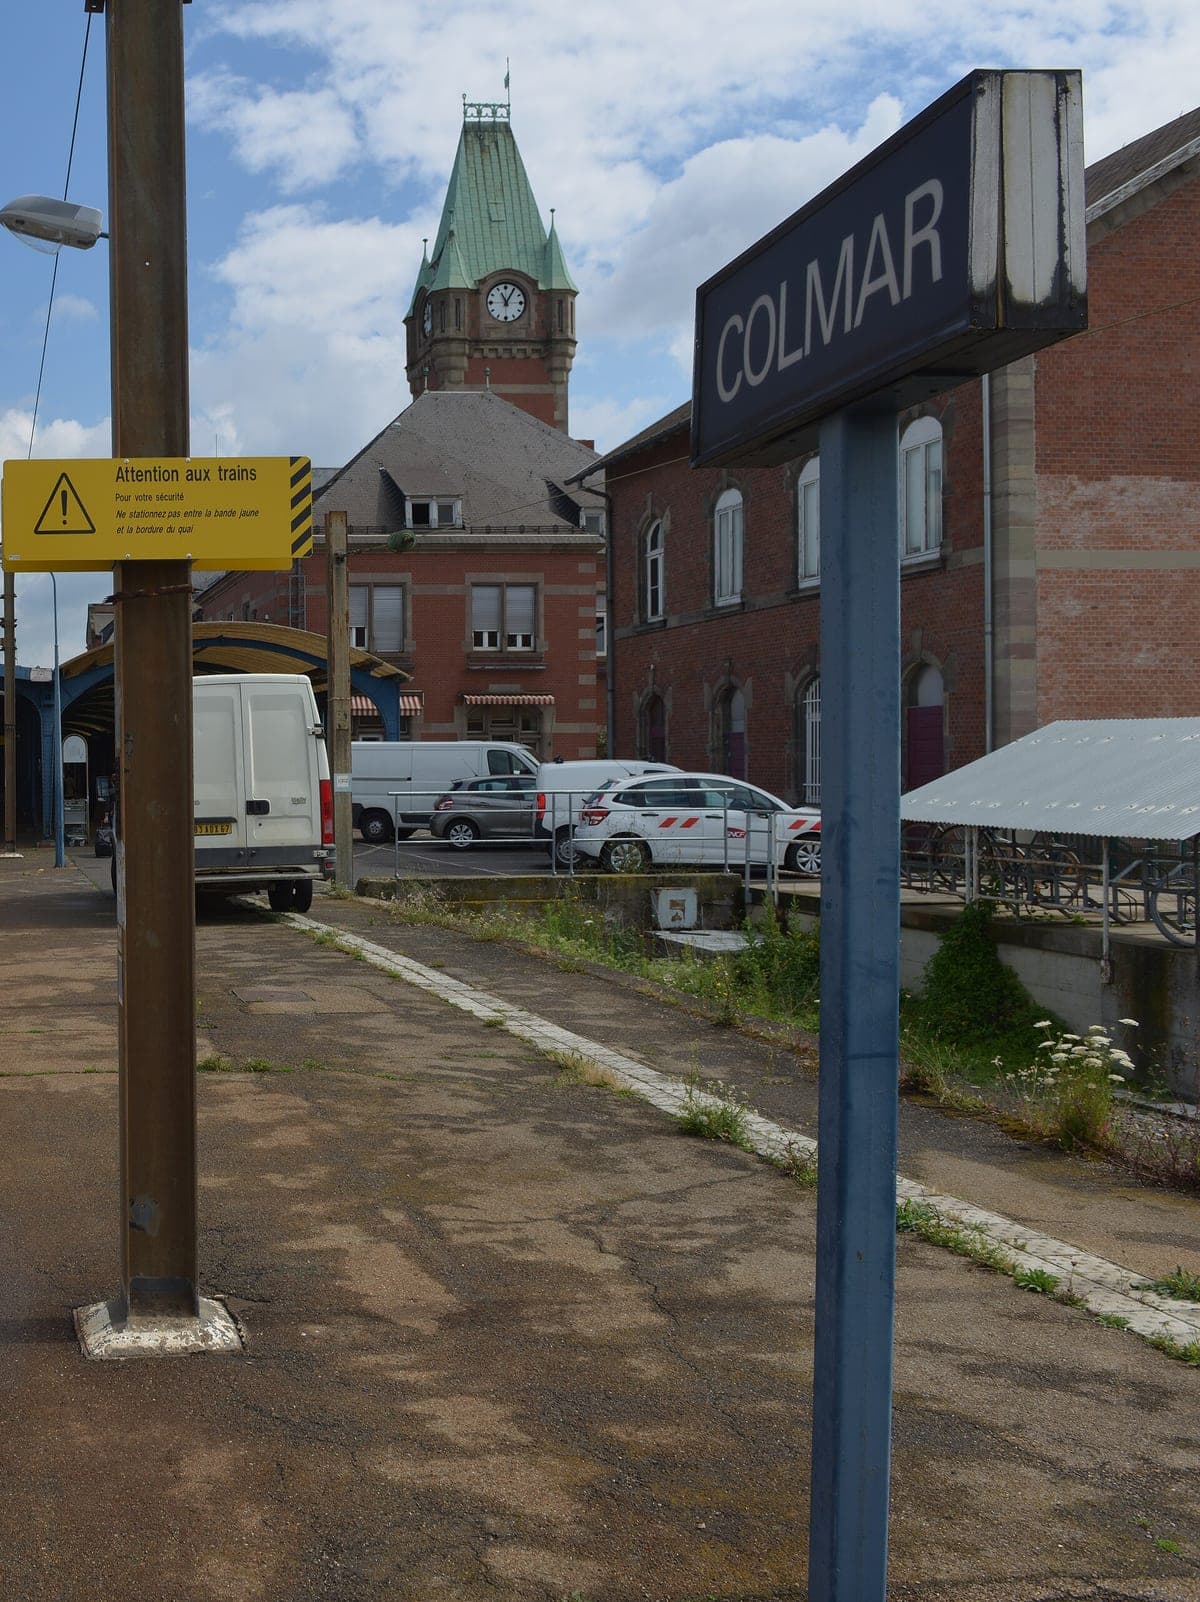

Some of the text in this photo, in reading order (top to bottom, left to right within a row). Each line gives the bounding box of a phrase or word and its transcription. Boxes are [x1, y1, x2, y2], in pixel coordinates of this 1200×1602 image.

[716, 178, 945, 403] COLMAR
[115, 465, 257, 482] Attention aux trains
[115, 492, 184, 502] Pour votre sécurité
[116, 508, 260, 521] Ne stationnez pas entre la bande jaune
[116, 525, 194, 536] et la bordure du quai
